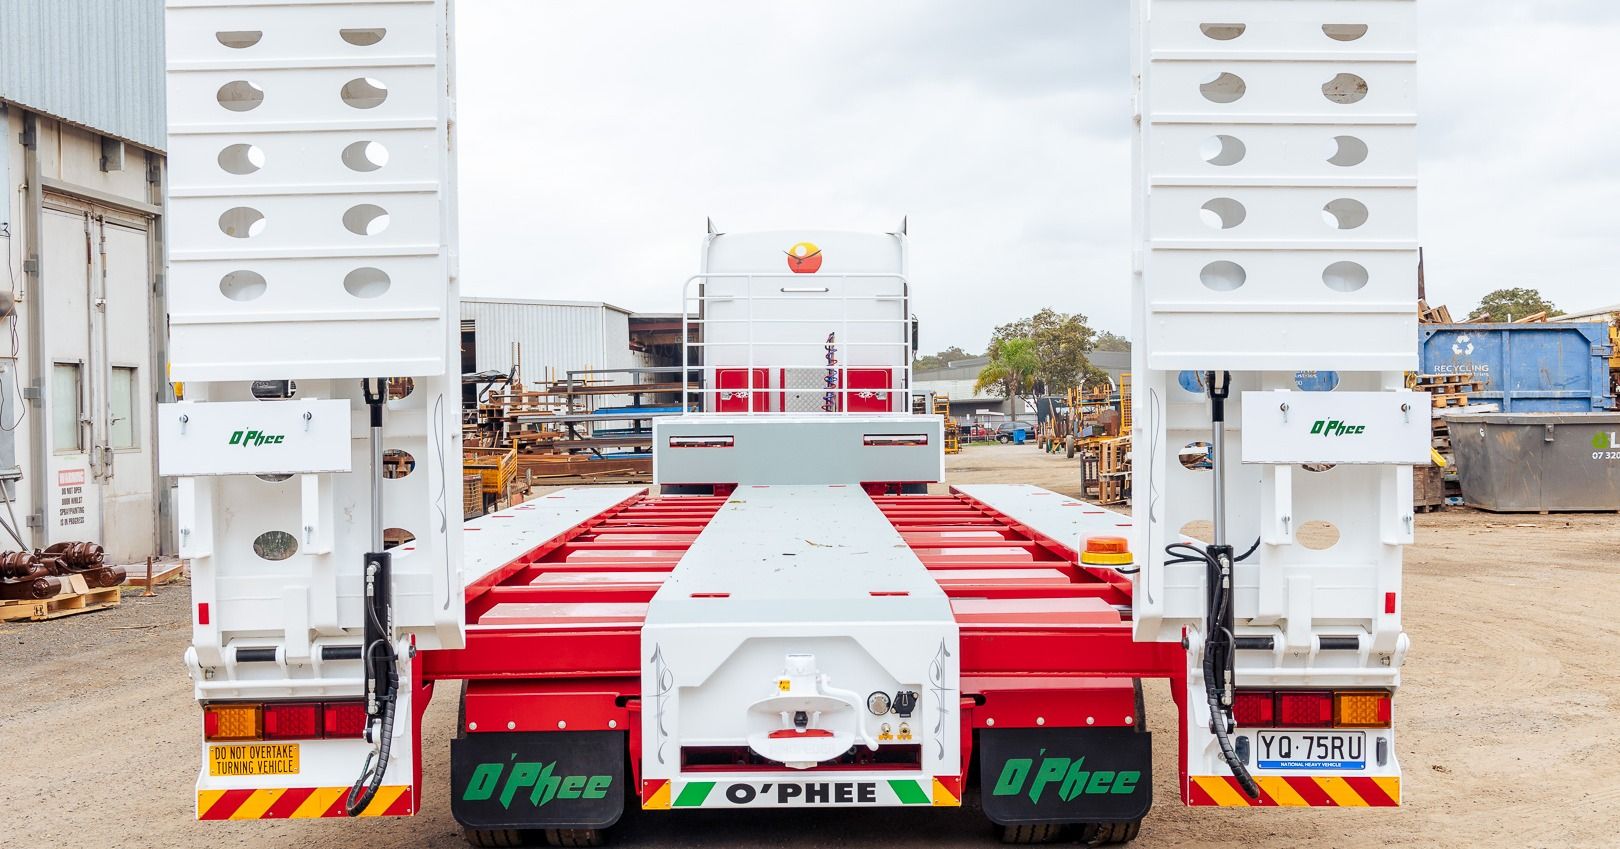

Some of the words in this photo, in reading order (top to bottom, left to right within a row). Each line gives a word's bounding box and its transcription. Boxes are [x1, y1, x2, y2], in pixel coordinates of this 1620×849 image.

[1434, 364, 1489, 372] RECYCLING
[1310, 417, 1366, 437] O'Phee
[228, 427, 285, 447] O'Phee
[1592, 451, 1604, 459] 07
[74, 486, 82, 494] OPEN
[69, 516, 84, 525] PROGRESS
[215, 746, 227, 760] DO
[230, 746, 246, 760] NOT
[249, 745, 293, 760] OVERTAKE
[216, 760, 254, 774] TURNING
[257, 759, 293, 773] VEHICLE
[462, 753, 613, 809] O'Phee
[991, 748, 1142, 805] O'Phee
[725, 782, 877, 805] O'PHEE
